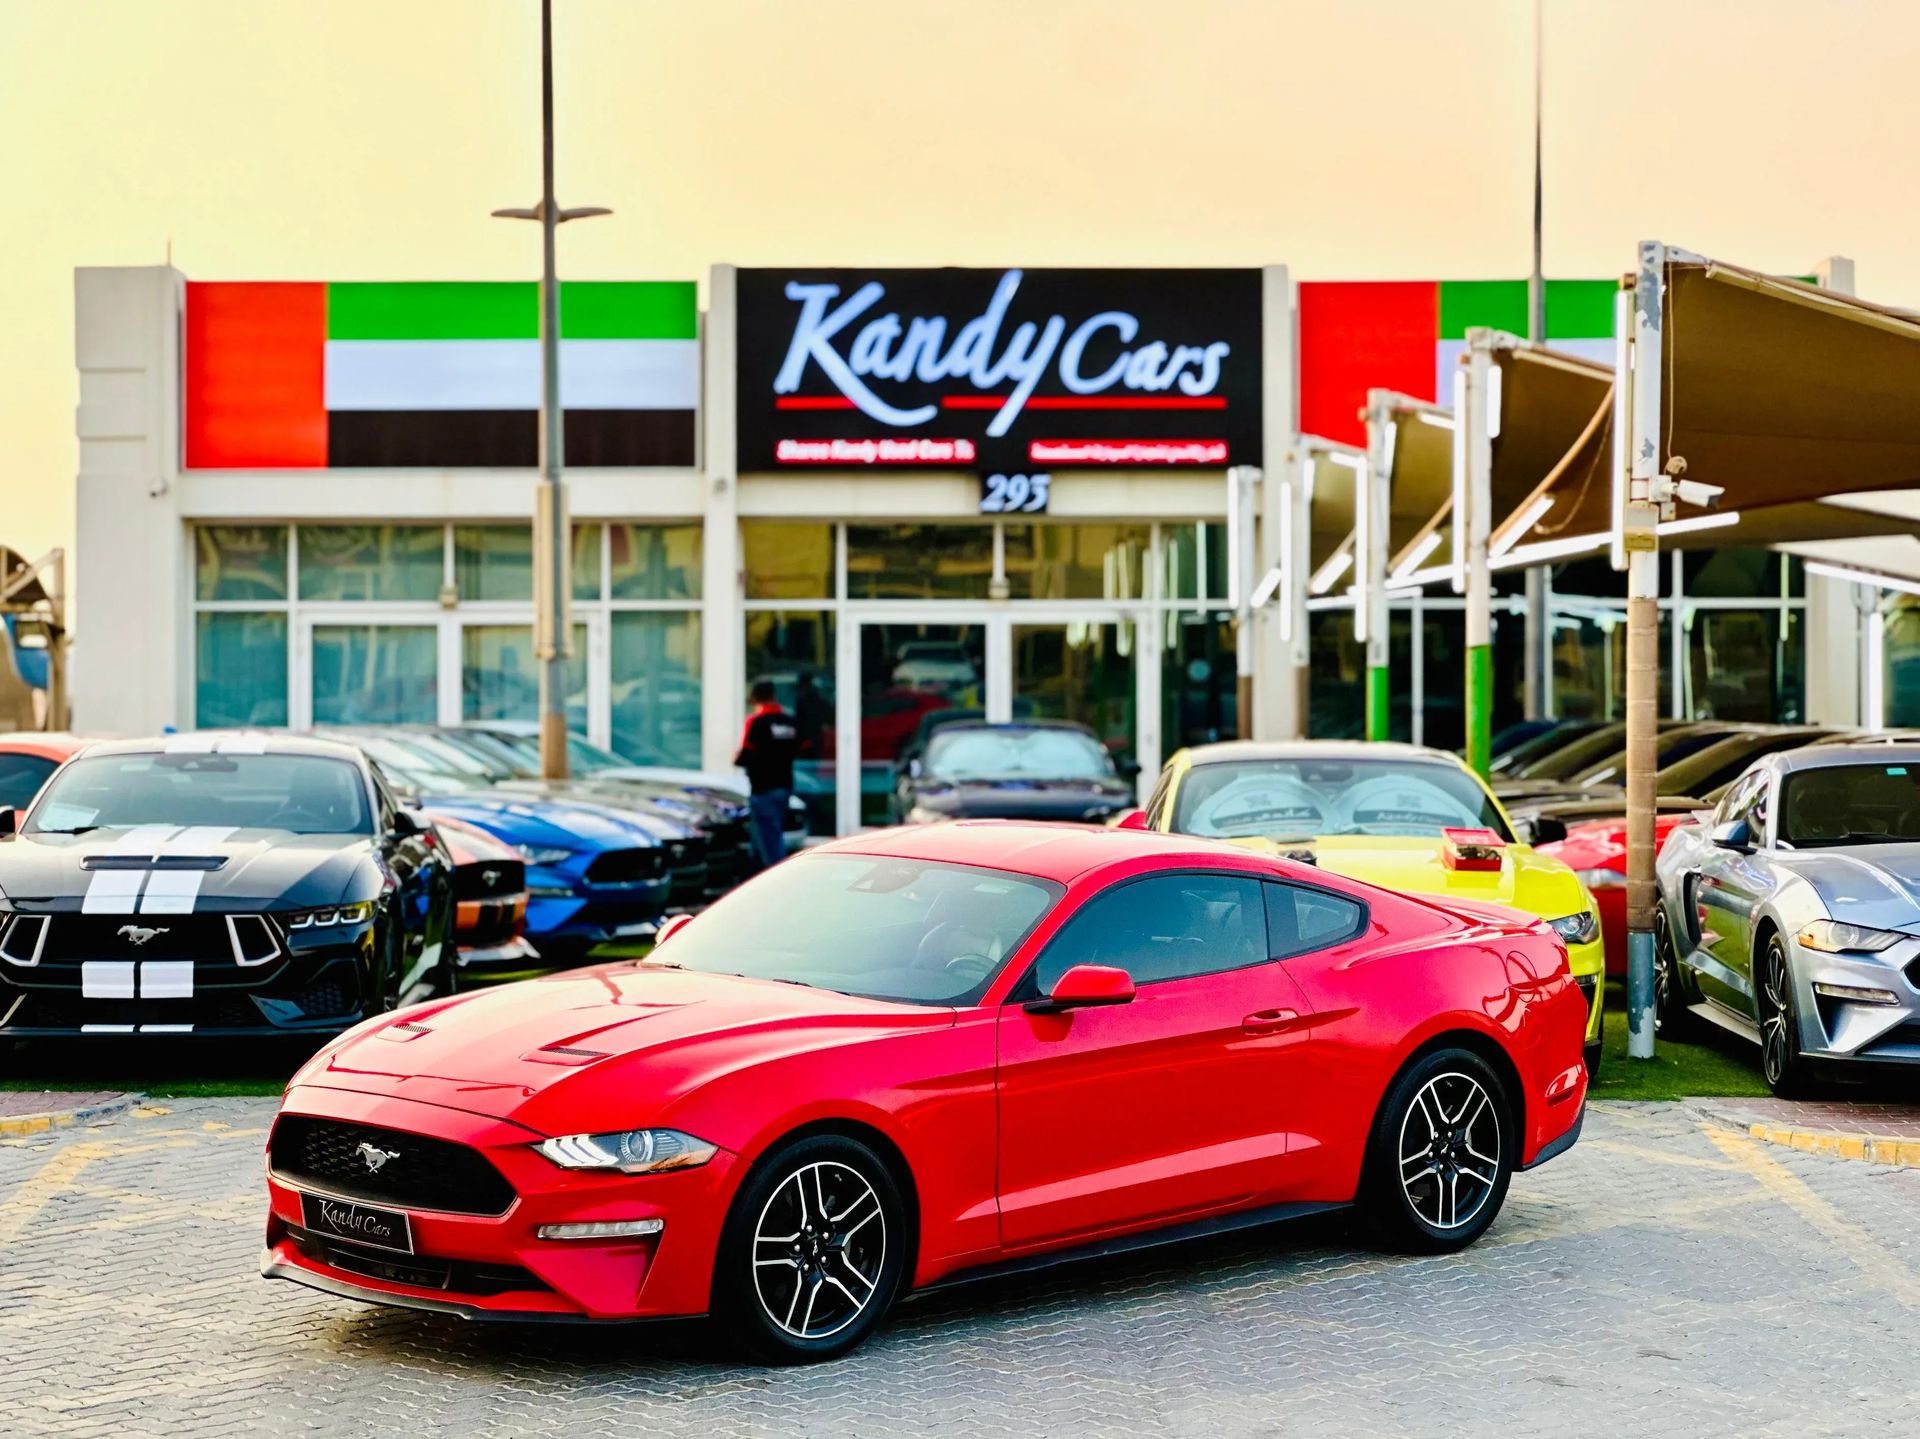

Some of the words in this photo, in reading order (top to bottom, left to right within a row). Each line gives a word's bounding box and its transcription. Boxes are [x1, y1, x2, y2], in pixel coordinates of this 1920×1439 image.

[774, 269, 1065, 437] Kandy
[1059, 311, 1230, 396] Cars
[319, 1199, 362, 1234] Kandy
[363, 1216, 391, 1236] Cars
